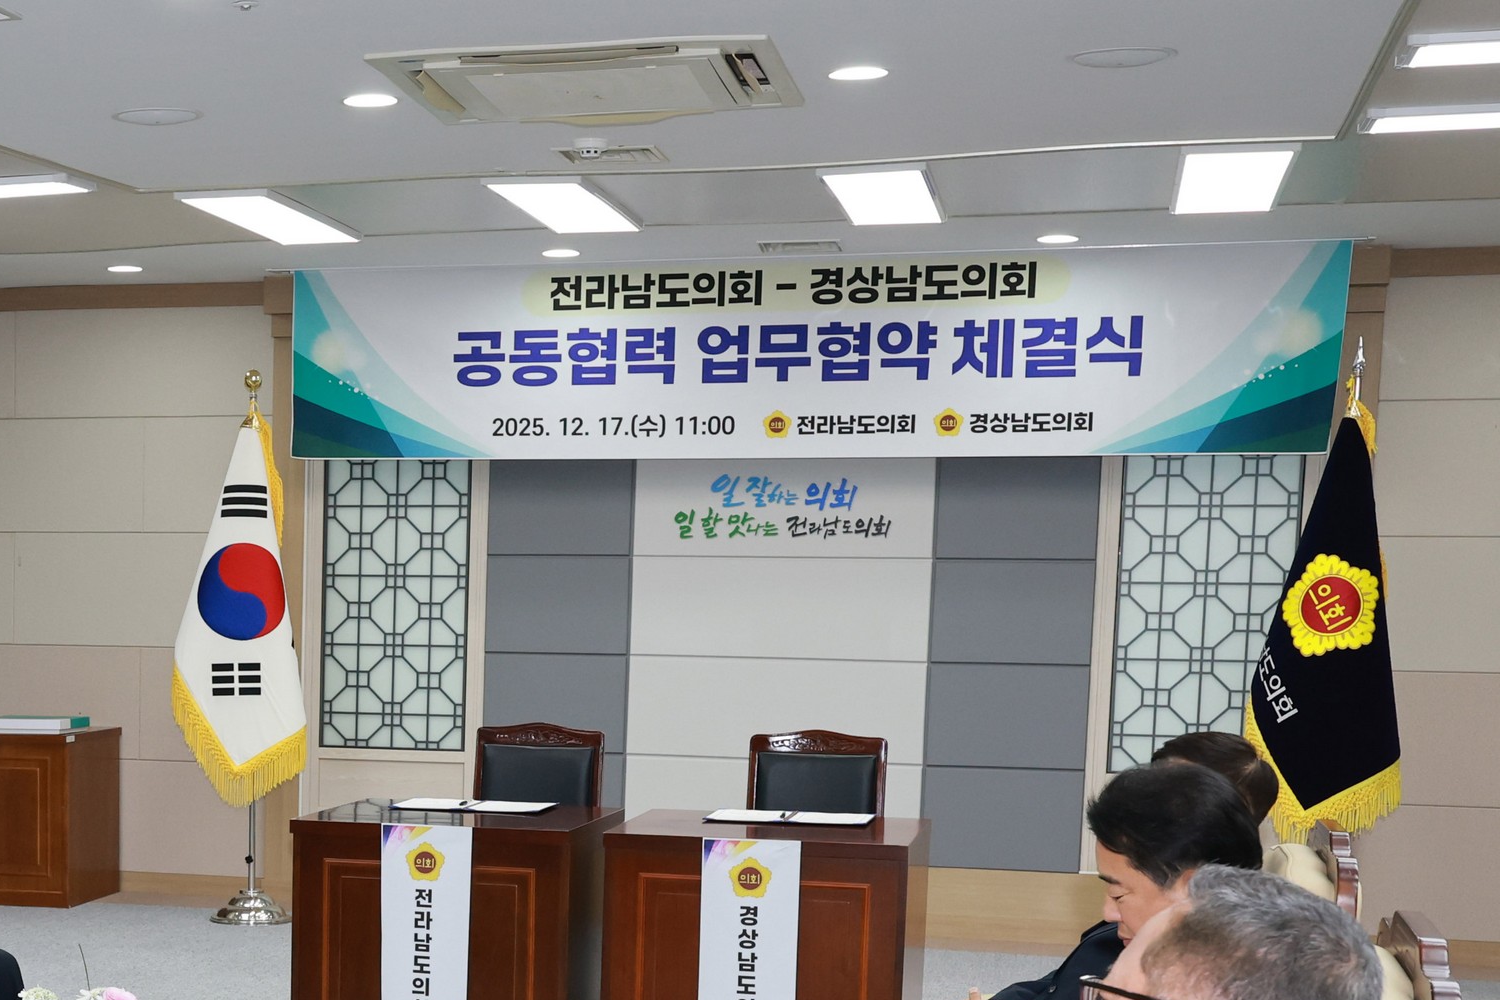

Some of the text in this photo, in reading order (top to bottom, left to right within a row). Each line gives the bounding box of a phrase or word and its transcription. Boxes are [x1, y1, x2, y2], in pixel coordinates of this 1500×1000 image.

[550, 269, 764, 311] 전라남도의회
[810, 261, 1038, 305] 경상남도의회
[453, 315, 1144, 388] 공동협력 업무협약 체결식
[492, 417, 550, 437] 2025.
[559, 417, 589, 436] 12.
[675, 415, 735, 436] 11:00
[796, 414, 916, 435] 전라남도의회
[969, 411, 1094, 434] 경상남도의회
[710, 473, 859, 511] 일 잘하는 의회
[674, 508, 696, 539] 일
[786, 514, 892, 540] 전라남도의회
[1308, 584, 1353, 631] 의회
[415, 857, 435, 869] 의회
[739, 873, 761, 885] 의회
